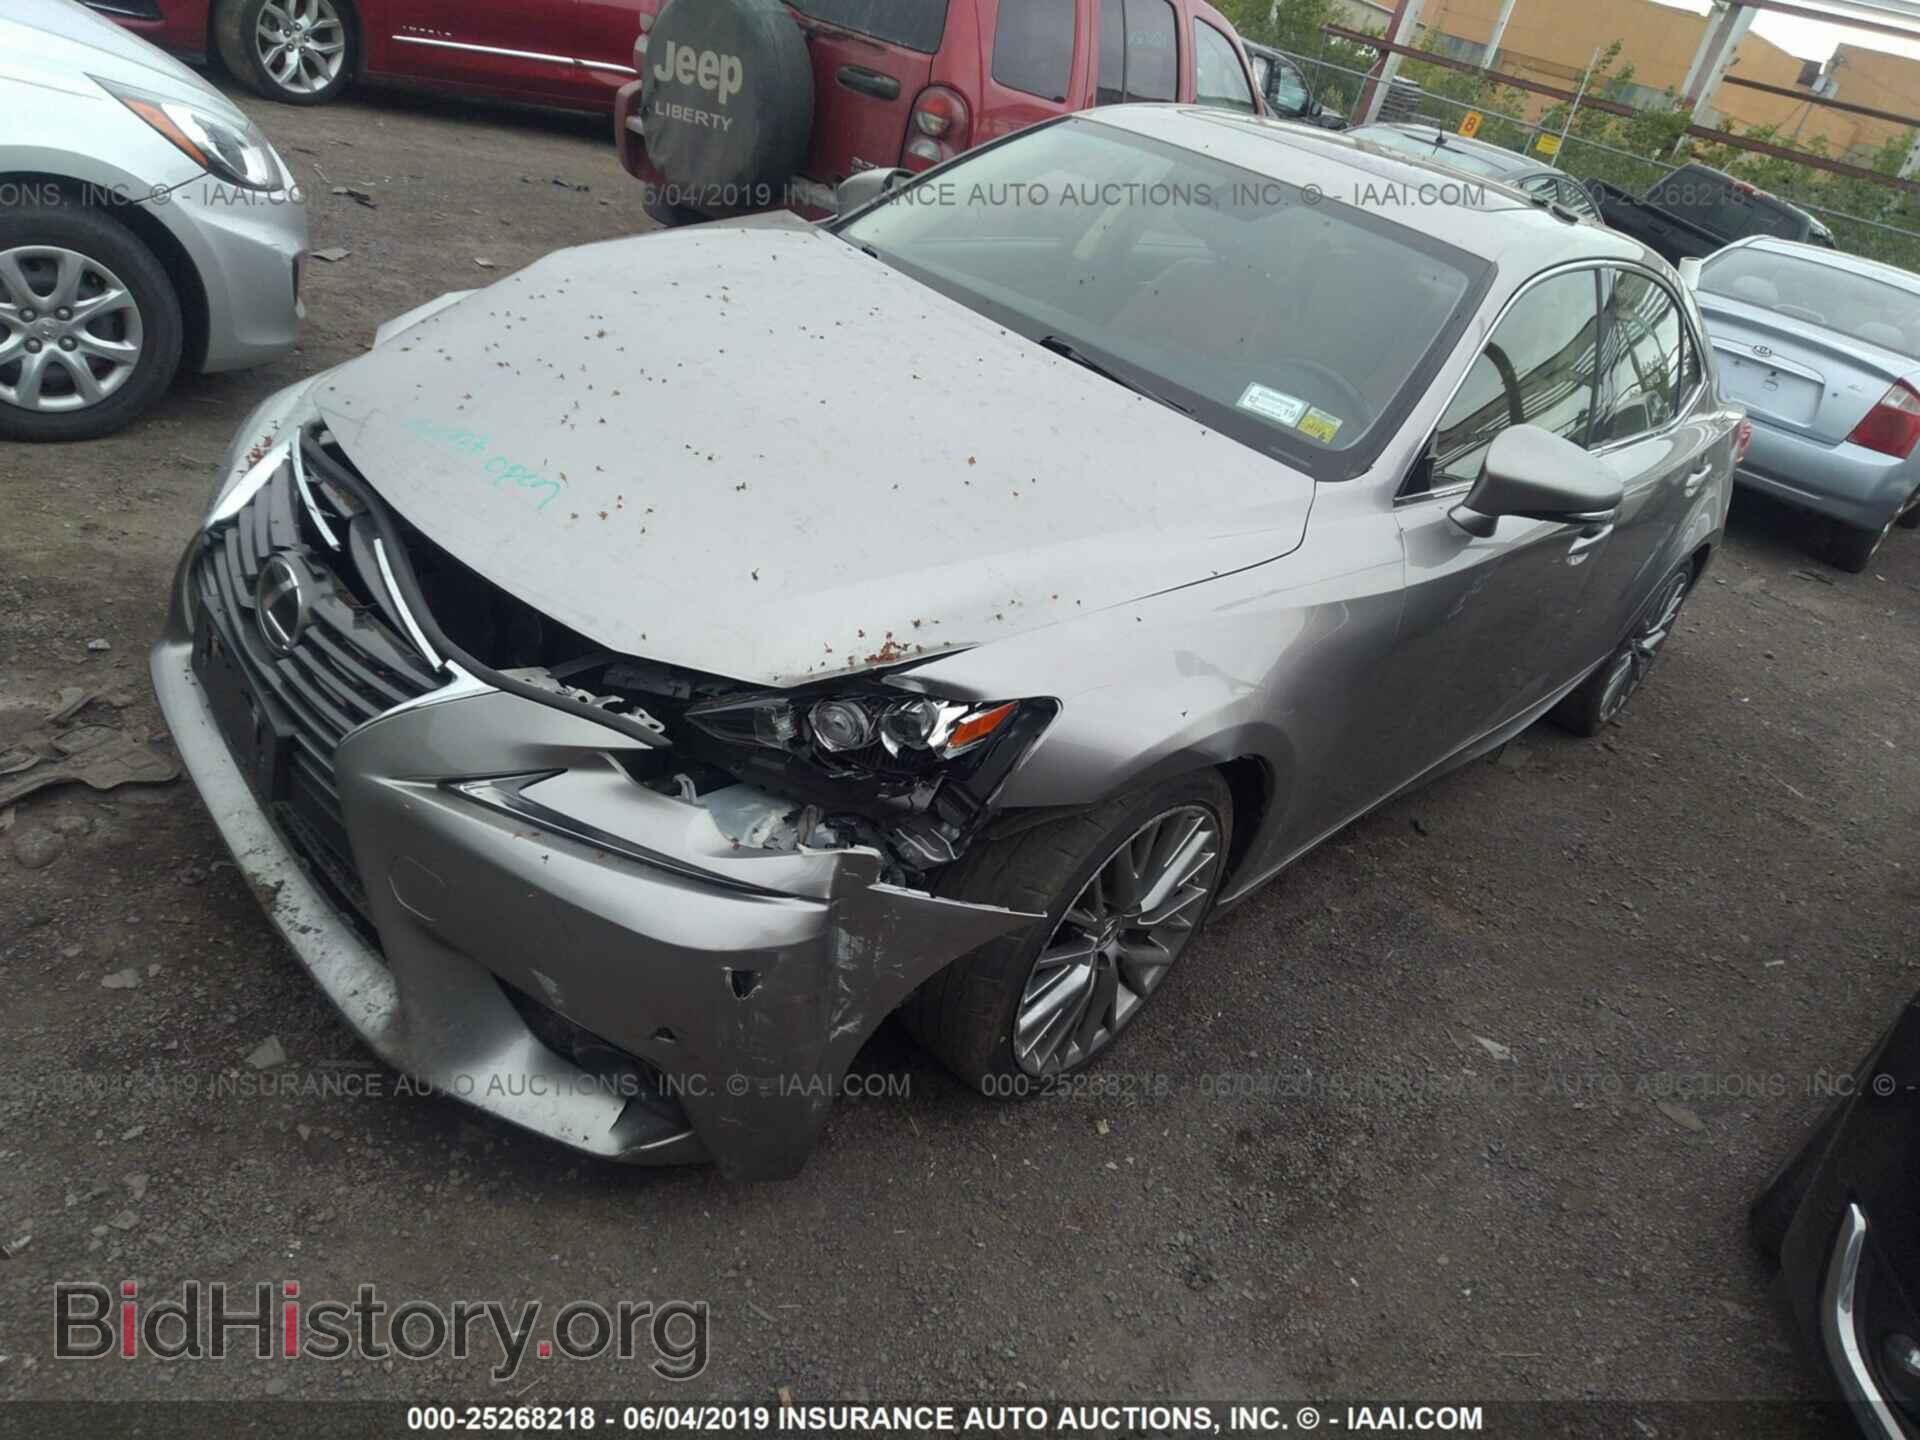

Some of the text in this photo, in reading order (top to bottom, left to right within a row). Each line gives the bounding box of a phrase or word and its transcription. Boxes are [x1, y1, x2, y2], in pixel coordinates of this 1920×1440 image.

[654, 40, 743, 104] Jeep
[655, 101, 733, 131] LIBERTY
[1465, 117, 1477, 131] 8
